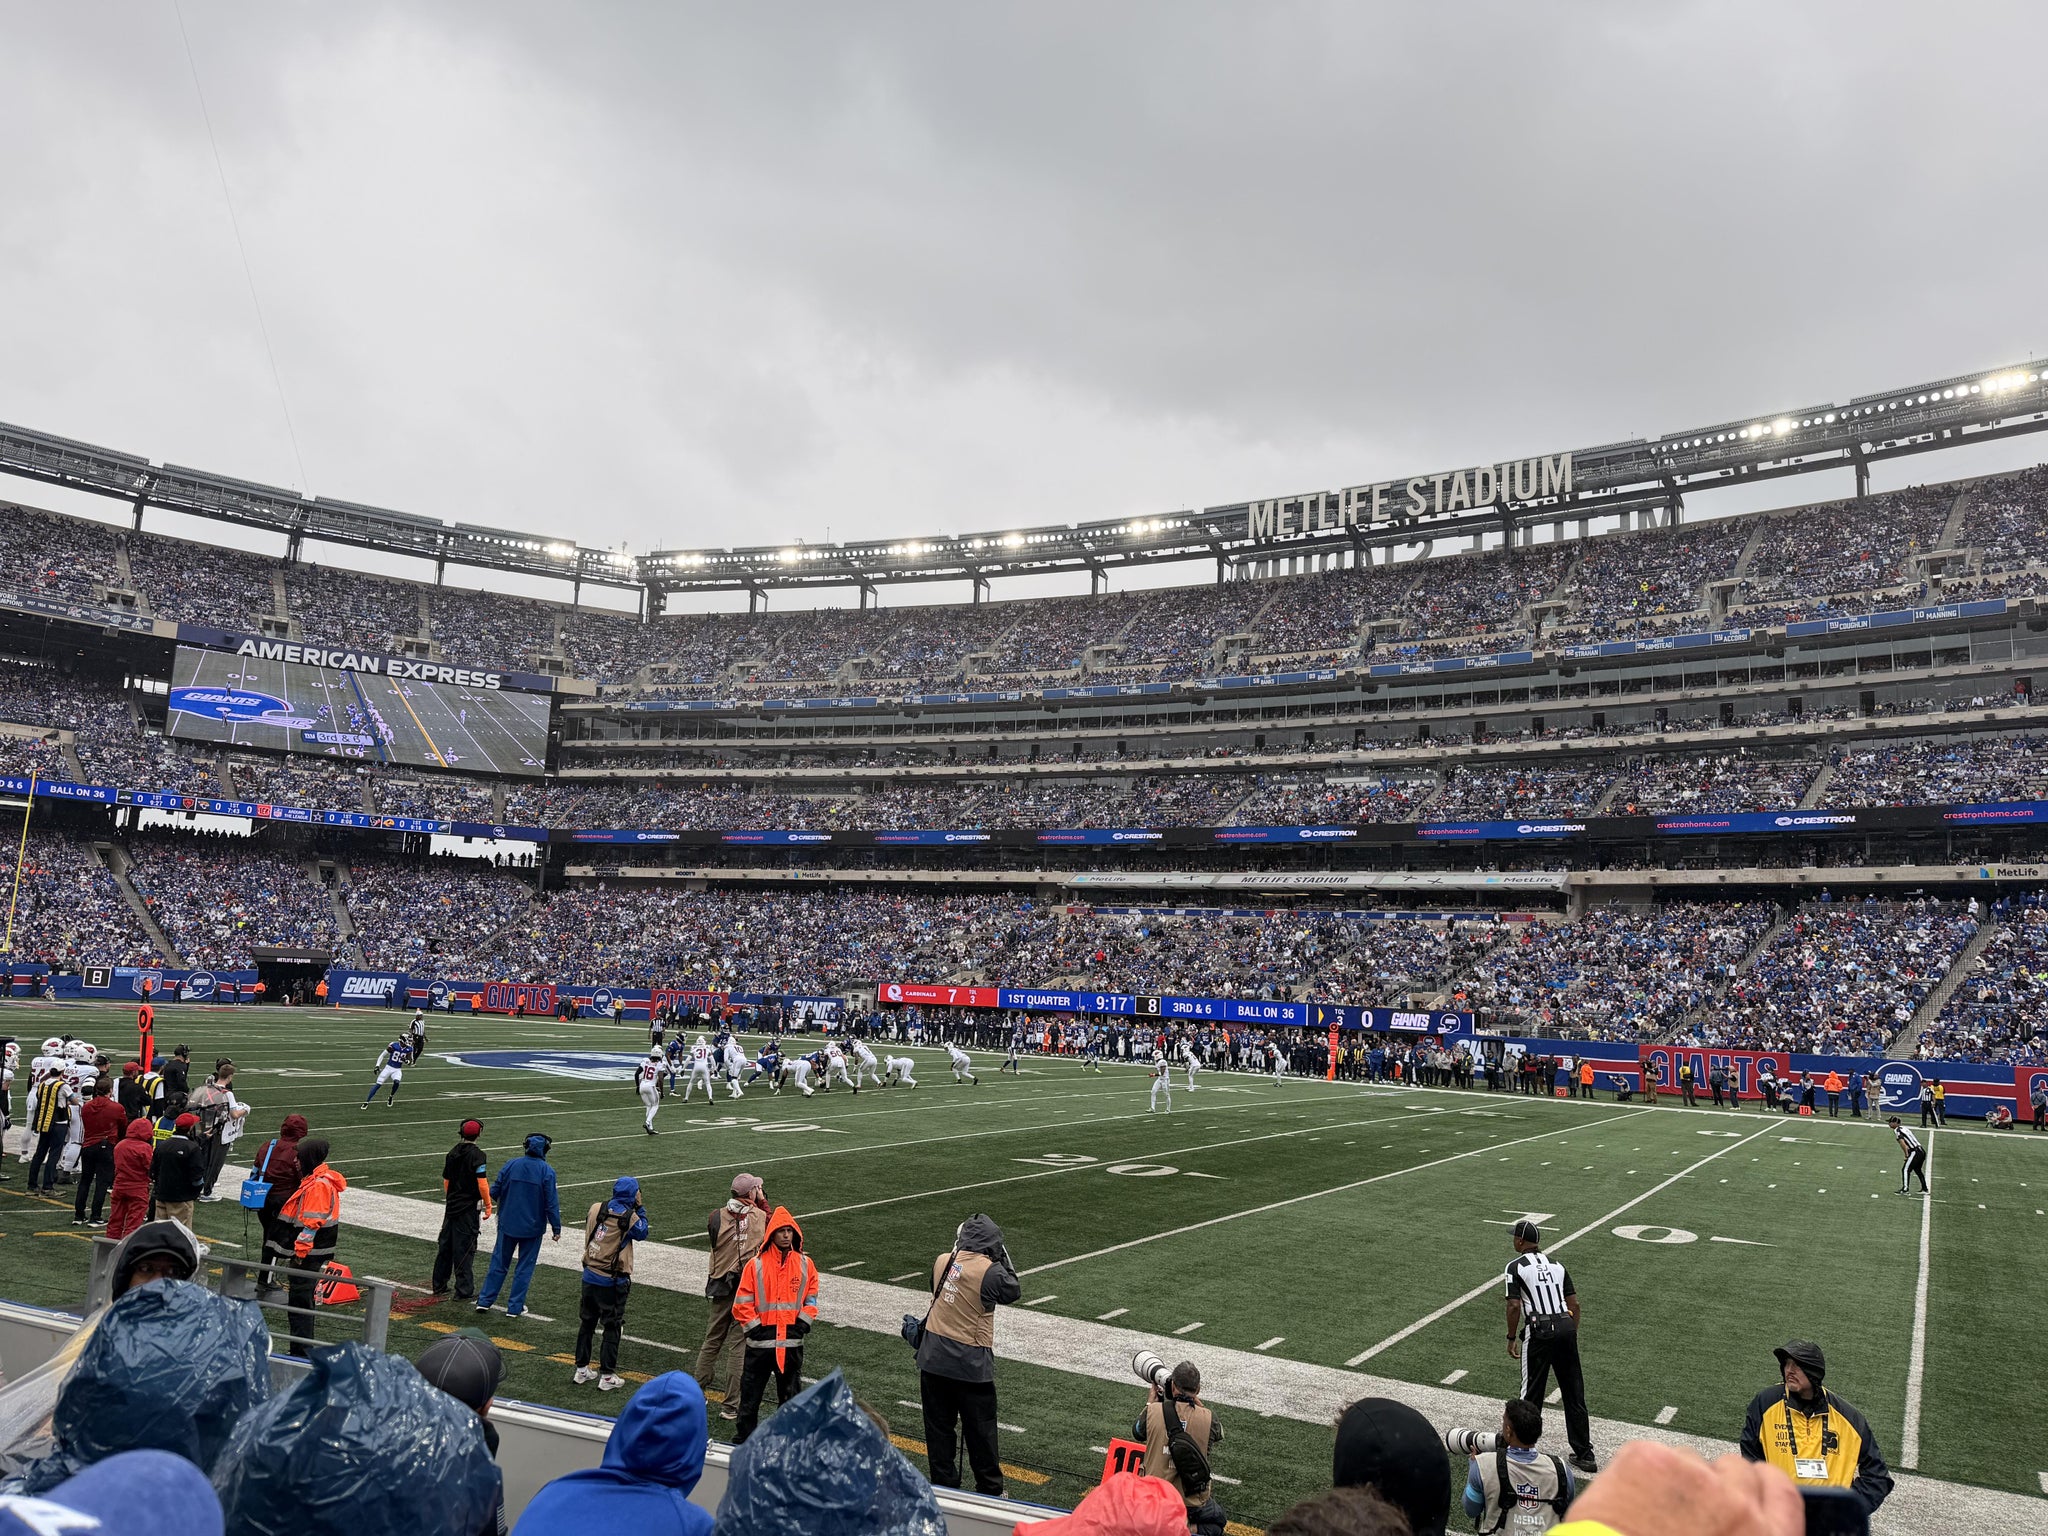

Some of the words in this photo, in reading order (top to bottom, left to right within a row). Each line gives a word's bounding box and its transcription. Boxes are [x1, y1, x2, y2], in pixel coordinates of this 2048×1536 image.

[1248, 483, 1392, 538] METLIFE
[1406, 453, 1573, 516] STADIUM
[1926, 610, 1957, 620] MANNING
[1840, 620, 1868, 630] COUGHLIN
[1724, 634, 1748, 642] ACCORSI
[1645, 642, 1672, 650] ARMSTEAD
[1574, 650, 1598, 658] STRAHAN
[236, 639, 380, 674] AMERICAN
[386, 660, 502, 690] EXPRESS
[182, 692, 262, 706] GIANTS
[319, 734, 338, 742] 3rd
[353, 735, 360, 743] 6
[8, 781, 14, 789] &
[16, 782, 23, 790] 6
[50, 785, 74, 796] BALL
[76, 788, 91, 798] ON
[93, 790, 105, 798] 36
[137, 794, 144, 803] 0
[170, 798, 176, 806] 0
[216, 802, 221, 810] 0
[1794, 816, 1856, 824] CRESTRON
[1944, 810, 2034, 820] crestronhome.com
[1656, 820, 1730, 828] crestronhome.com
[1998, 868, 2038, 876] MetLife
[92, 971, 102, 984] 8
[343, 977, 397, 994] GIANTS
[948, 989, 957, 1003] 7
[970, 995, 976, 1004] 3
[1008, 994, 1024, 1004] 1ST
[1027, 994, 1070, 1006] QUARTER
[1096, 996, 1128, 1011] 9:17
[1148, 999, 1157, 1013] 8
[1173, 1002, 1193, 1013] 3RD
[1196, 1004, 1202, 1014] &
[1205, 1004, 1212, 1014] 6
[1238, 1006, 1261, 1017] BALL
[1263, 1007, 1277, 1018] ON
[1282, 1009, 1294, 1019] 36
[1337, 1015, 1343, 1026] 3
[1361, 1011, 1373, 1028] 0
[1390, 1012, 1430, 1027] GIANTS
[696, 1049, 706, 1059] 31
[1456, 1039, 1526, 1066] GIATS
[644, 1066, 655, 1080] 16
[1885, 1073, 1913, 1083] GIANTS
[1800, 1106, 1809, 1114] 10
[1538, 1272, 1554, 1283] 41
[1114, 1446, 1145, 1476] 10
[1514, 1514, 1545, 1526] MEDIA
